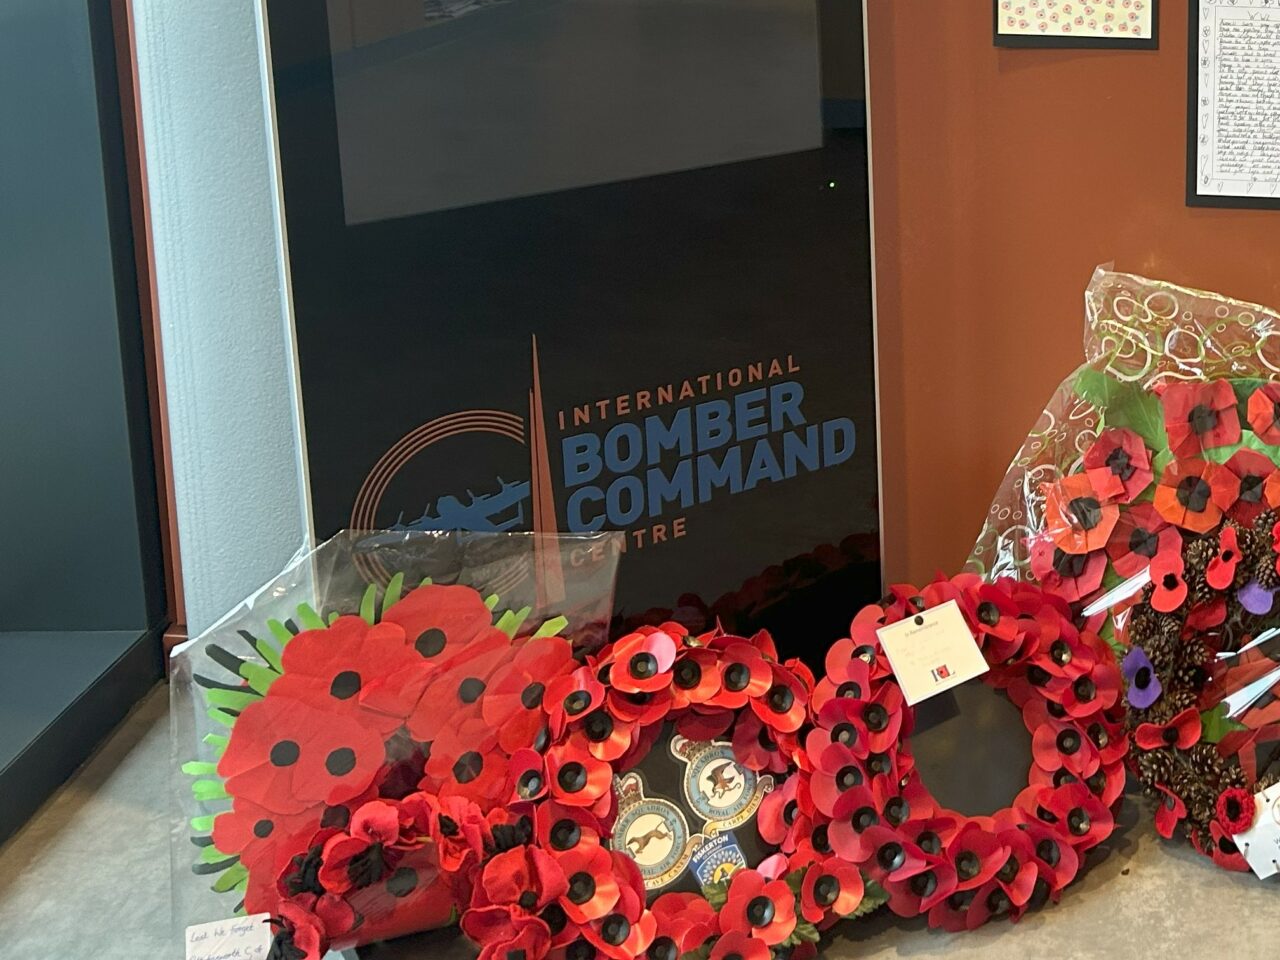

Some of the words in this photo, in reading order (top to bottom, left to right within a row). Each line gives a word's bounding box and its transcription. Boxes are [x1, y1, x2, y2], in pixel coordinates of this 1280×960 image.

[557, 353, 801, 431] INTERNATIONAL
[561, 381, 807, 488] BOMBER
[566, 416, 857, 533] COMMAND
[569, 517, 688, 568] CENTRE
[692, 834, 729, 863] FISKERTON
